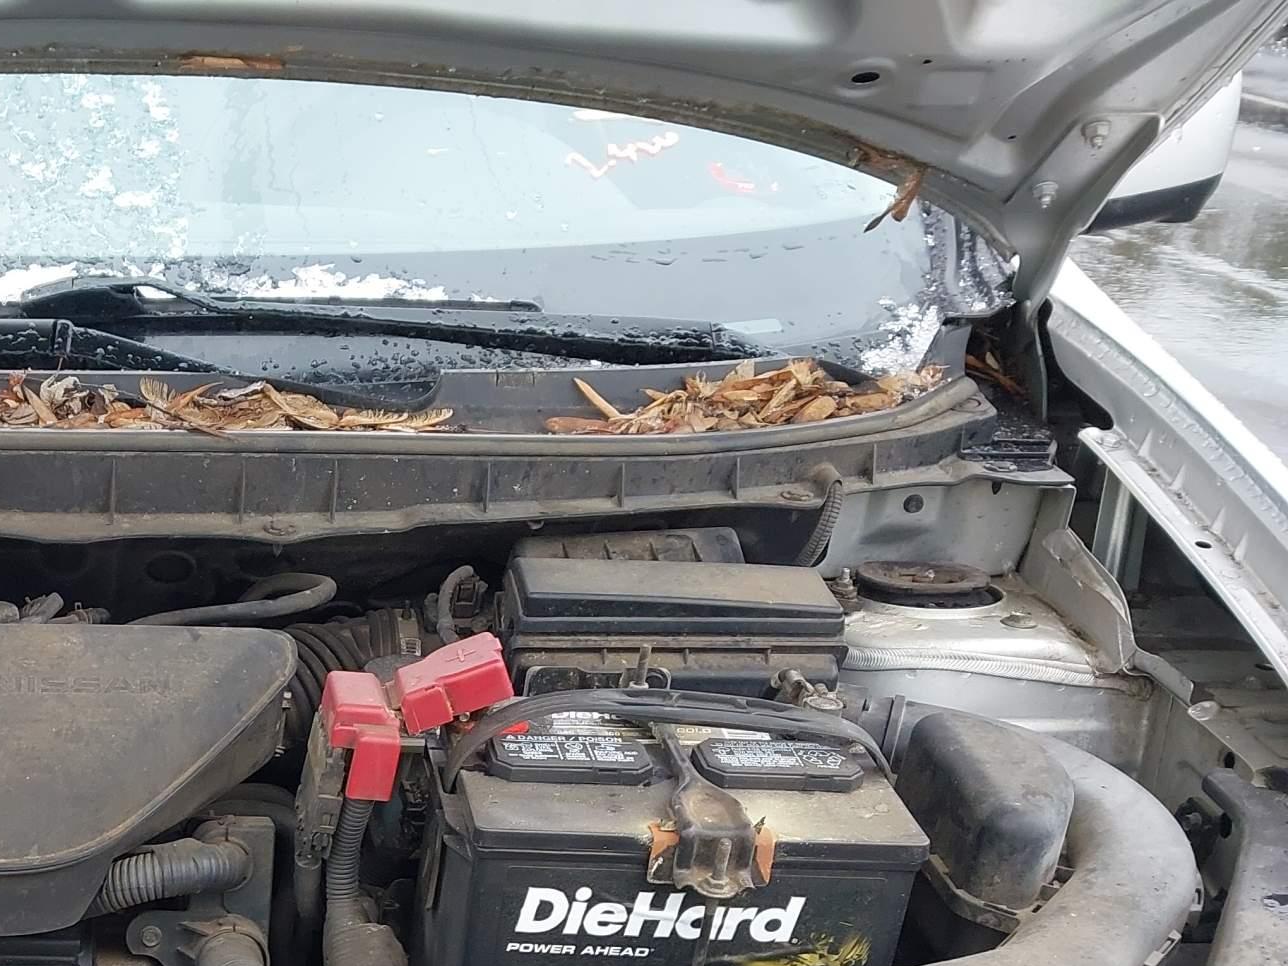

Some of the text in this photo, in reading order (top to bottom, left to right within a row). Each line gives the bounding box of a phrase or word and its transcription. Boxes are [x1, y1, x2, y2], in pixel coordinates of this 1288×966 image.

[515, 886, 806, 943] DieHard
[506, 942, 651, 958] POWER AHEAD
